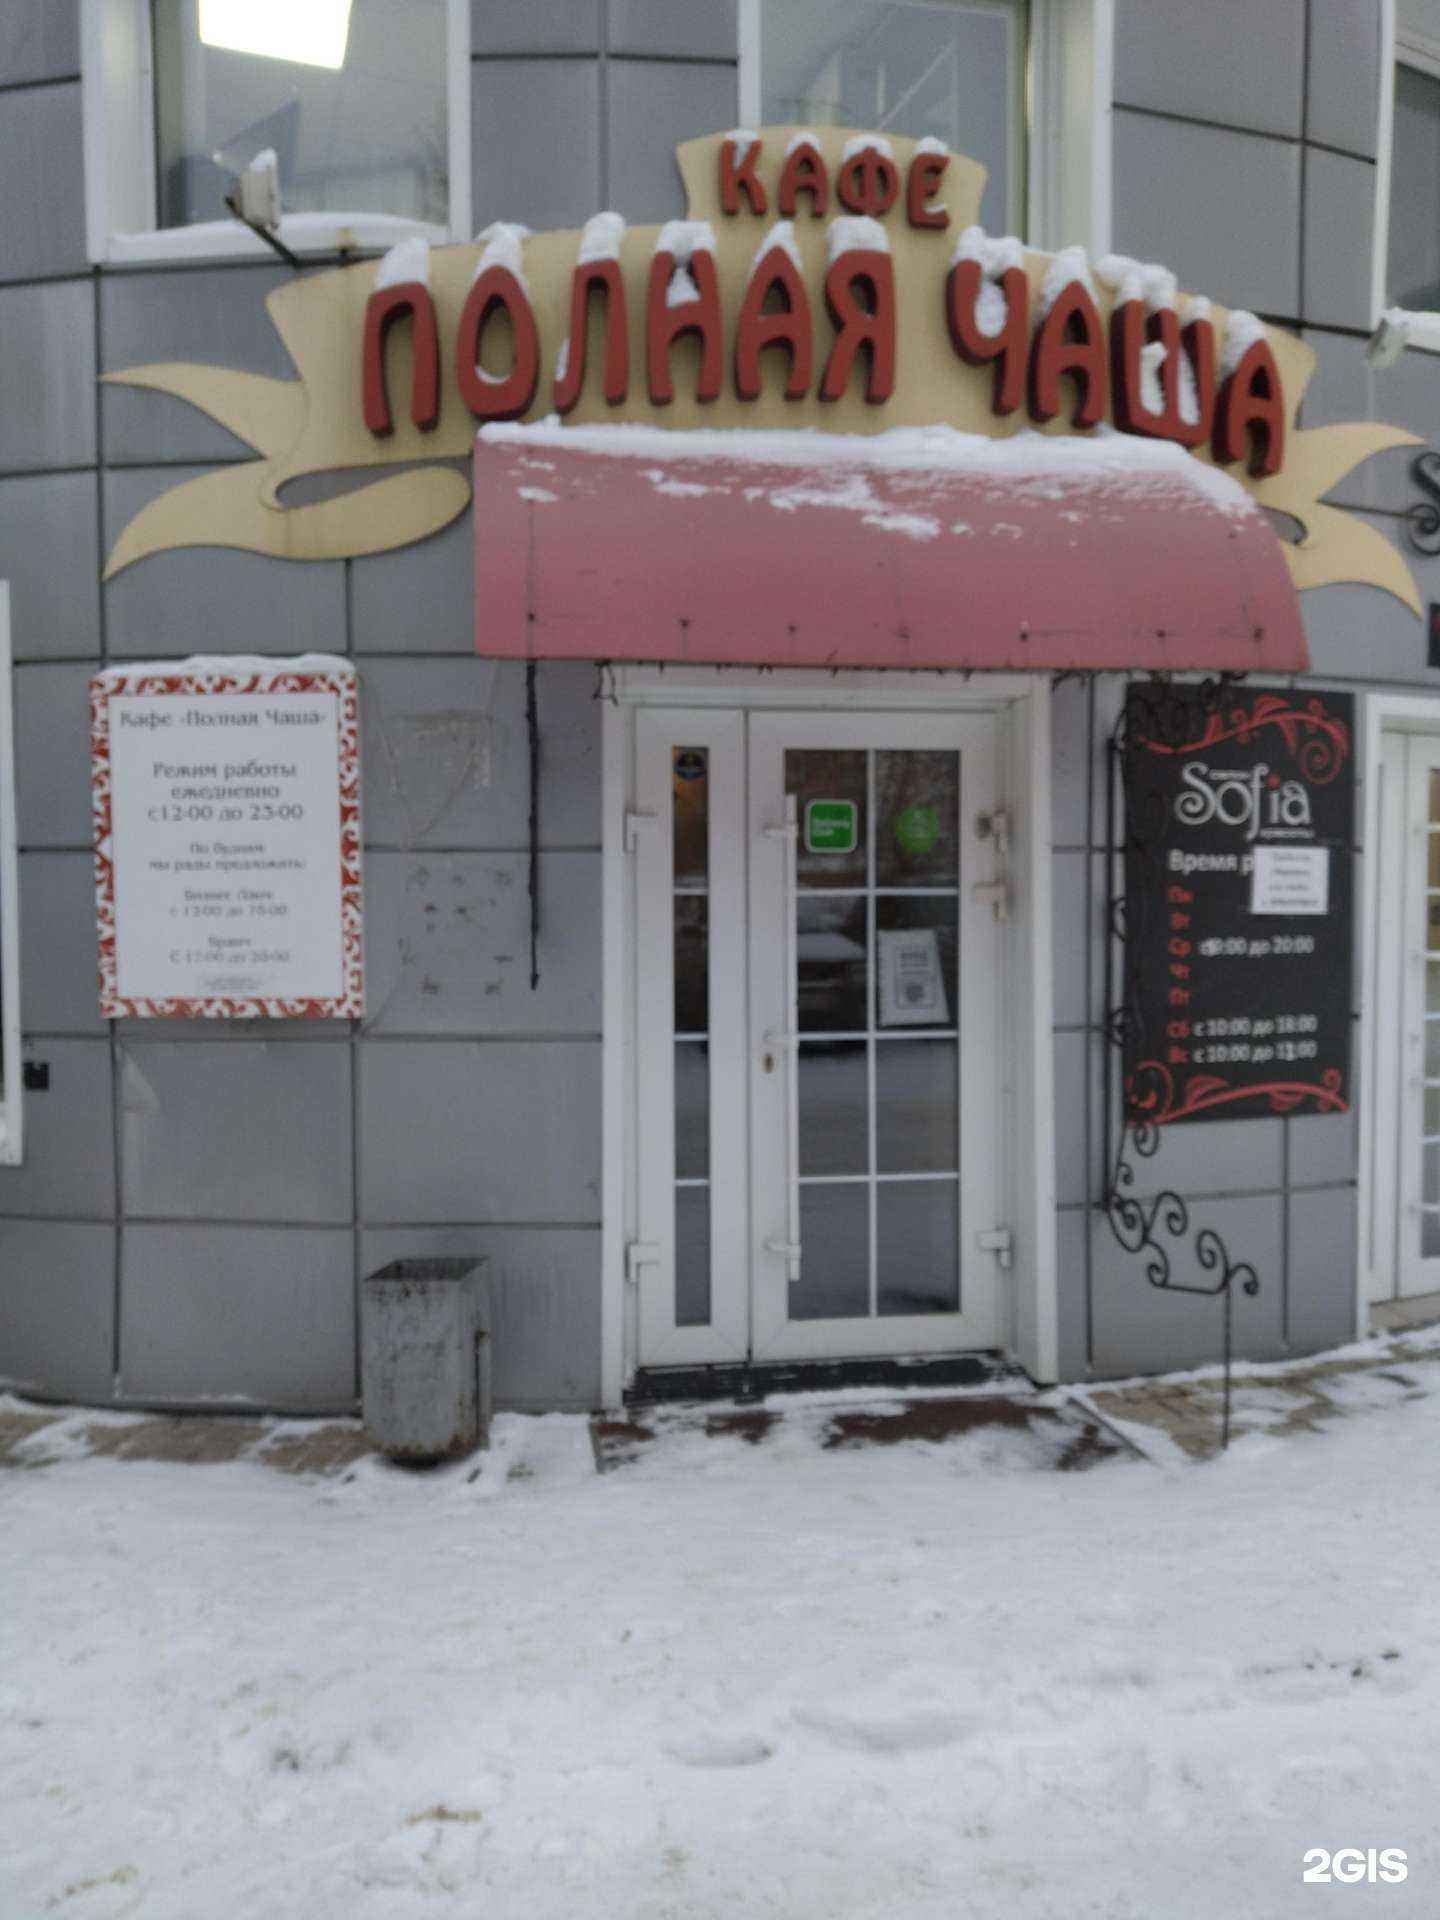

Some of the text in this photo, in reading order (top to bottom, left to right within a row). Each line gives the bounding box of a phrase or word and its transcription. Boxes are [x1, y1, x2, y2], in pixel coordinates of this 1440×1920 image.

[718, 135, 952, 230] КАФЕ
[361, 241, 1287, 479] ПОЛНАЯ ЧАША
[120, 709, 171, 731] Кафе
[153, 758, 298, 782] Режим работы
[170, 785, 280, 800] ежедневно
[1173, 761, 1312, 842] Sofia
[218, 806, 243, 822] до
[174, 861, 212, 876] рады
[1168, 848, 1237, 877] Время
[1249, 940, 1270, 957] до
[1271, 935, 1315, 955] 20:00
[1192, 1021, 1206, 1038] с
[1206, 1016, 1250, 1037] 10:00
[1251, 1019, 1274, 1038] до
[1192, 1047, 1206, 1064] с
[1206, 1043, 1250, 1063] 10:00
[1251, 1045, 1274, 1064] до
